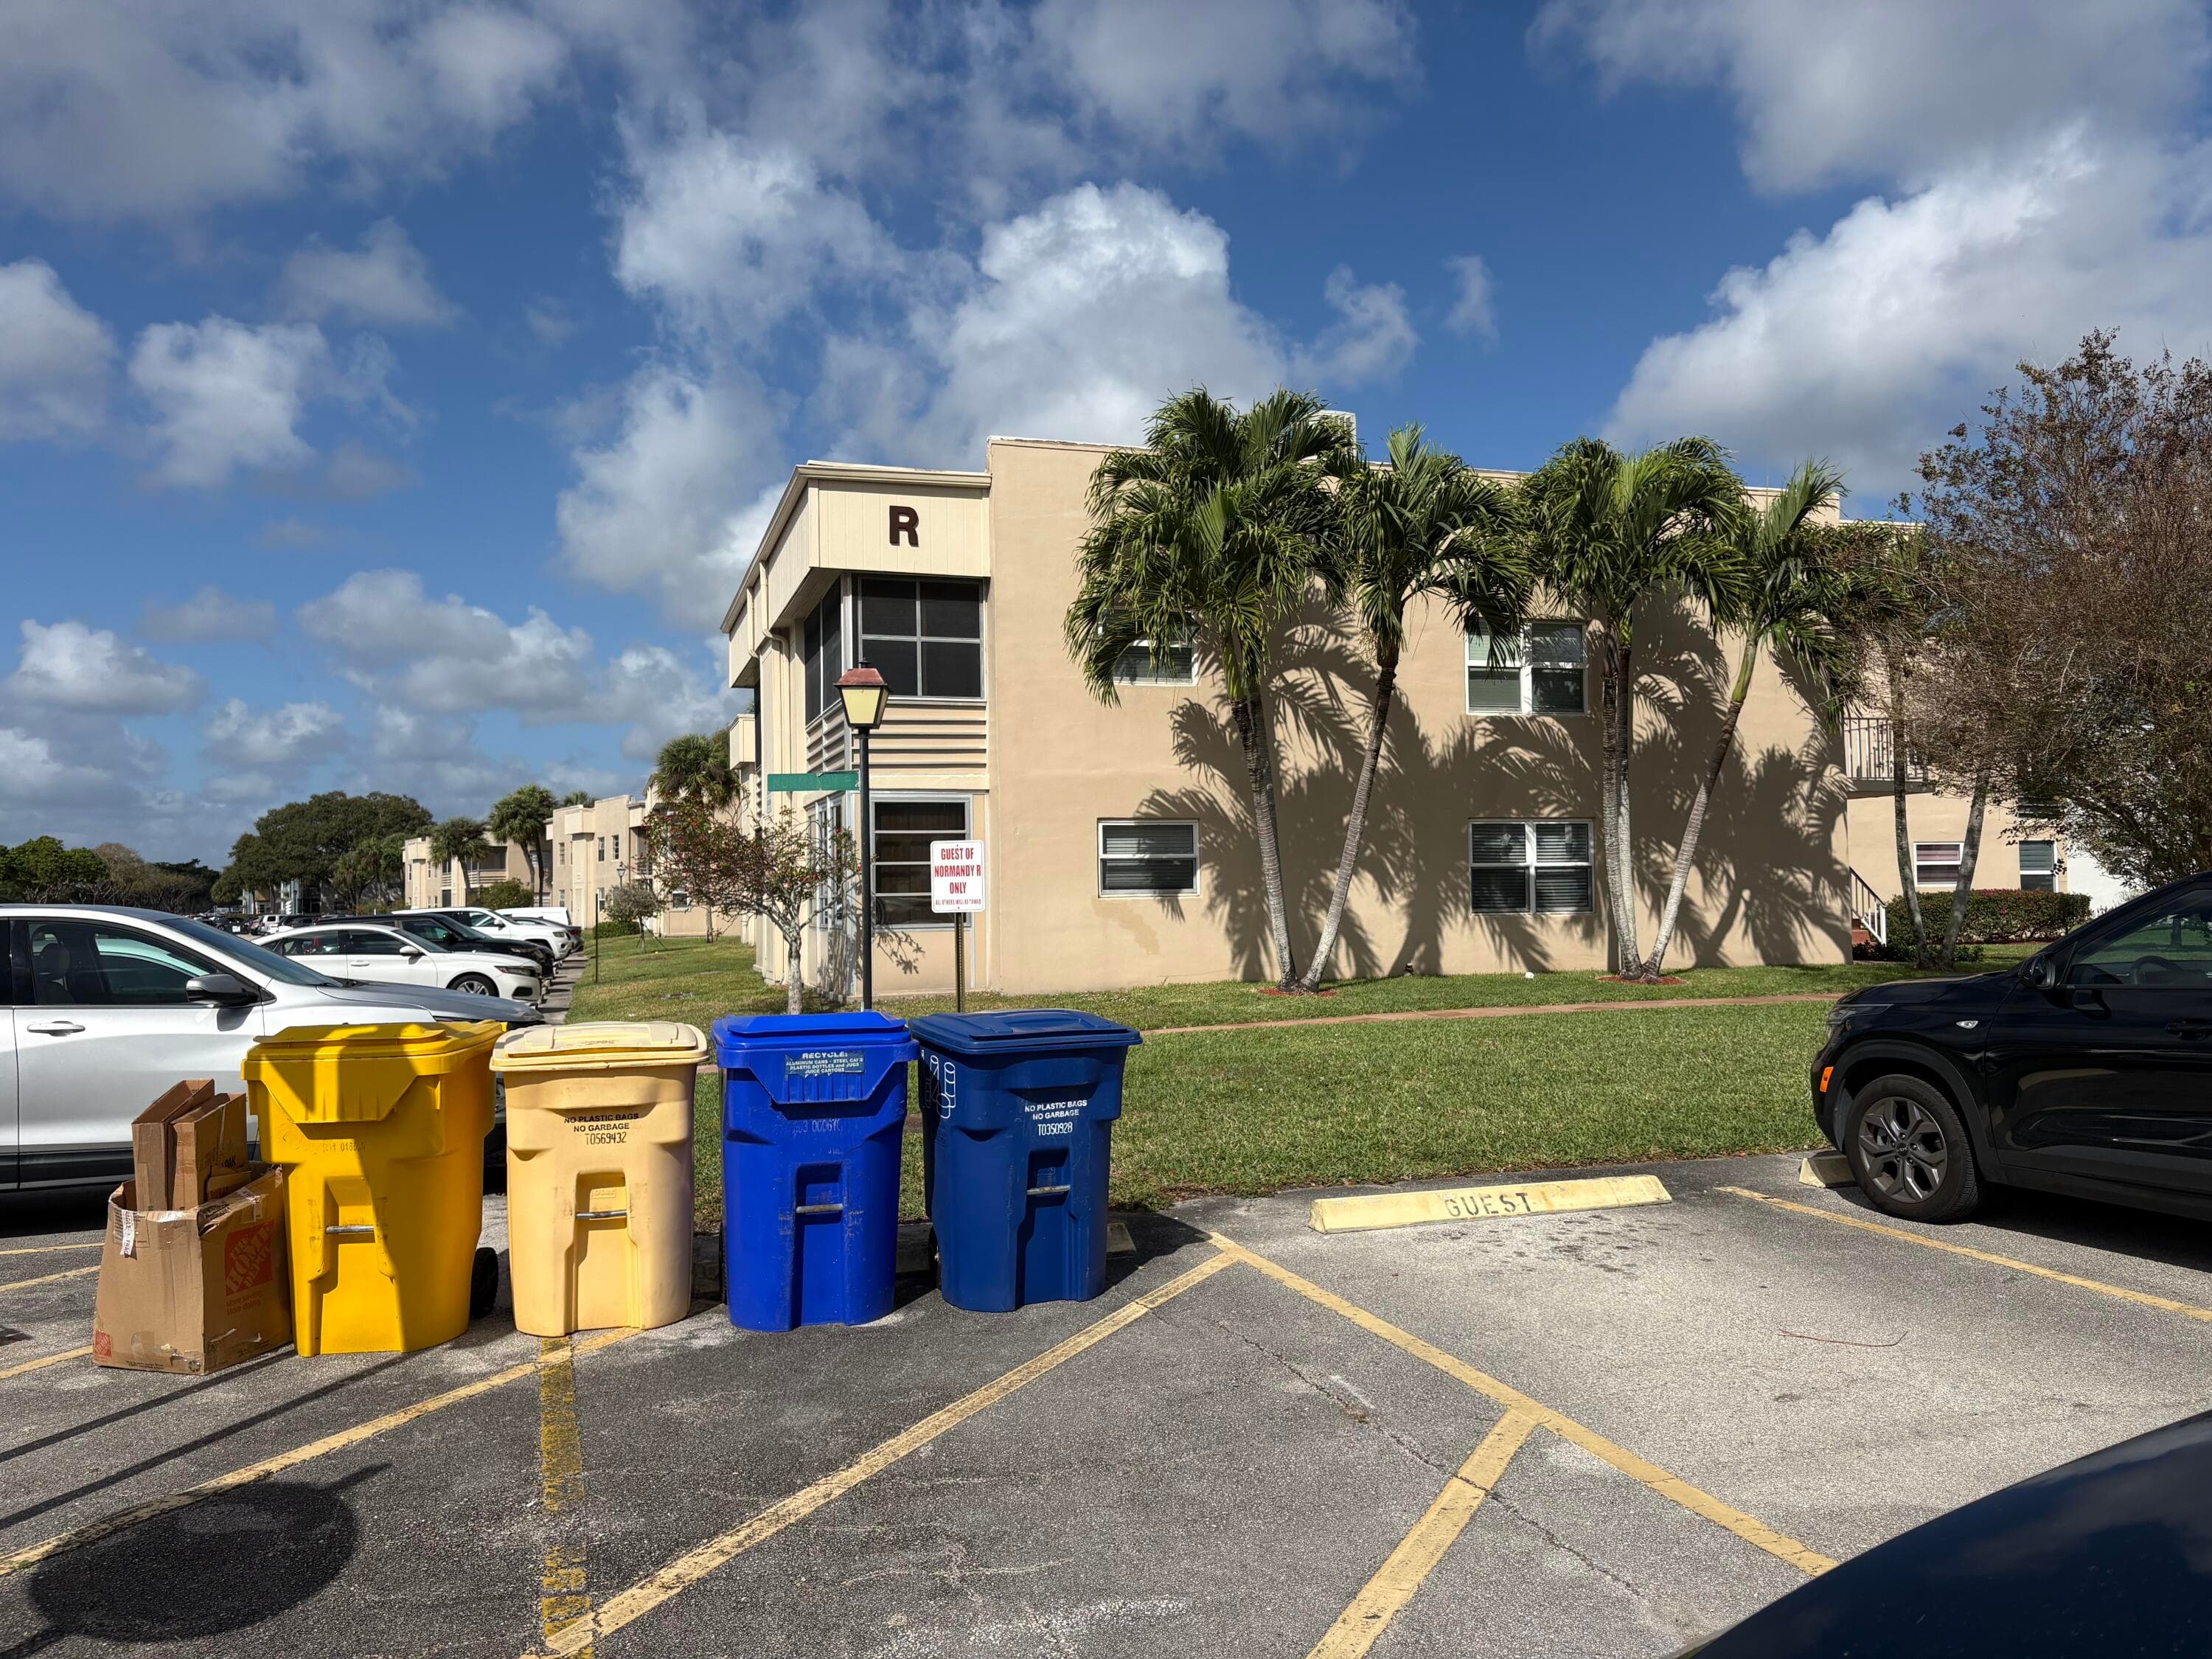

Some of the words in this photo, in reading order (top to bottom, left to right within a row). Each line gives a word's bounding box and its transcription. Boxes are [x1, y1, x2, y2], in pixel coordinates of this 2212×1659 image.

[889, 505, 919, 547] R
[941, 848, 964, 860] GUEST
[965, 848, 973, 860] OF
[934, 865, 974, 877] NORMANDY
[976, 865, 981, 876] R
[949, 882, 967, 894] ONLY
[1037, 1102, 1066, 1110] PLASTIC
[1067, 1099, 1088, 1108] BAGS
[578, 1114, 613, 1123] PLASTIC
[616, 1113, 639, 1121] BAGS
[1045, 1109, 1079, 1119] GARBAGE
[588, 1122, 630, 1132] GARBAGE
[1037, 1121, 1073, 1136] T0350928
[585, 1132, 627, 1144] T0569432
[1444, 1192, 1531, 1217] GUEST
